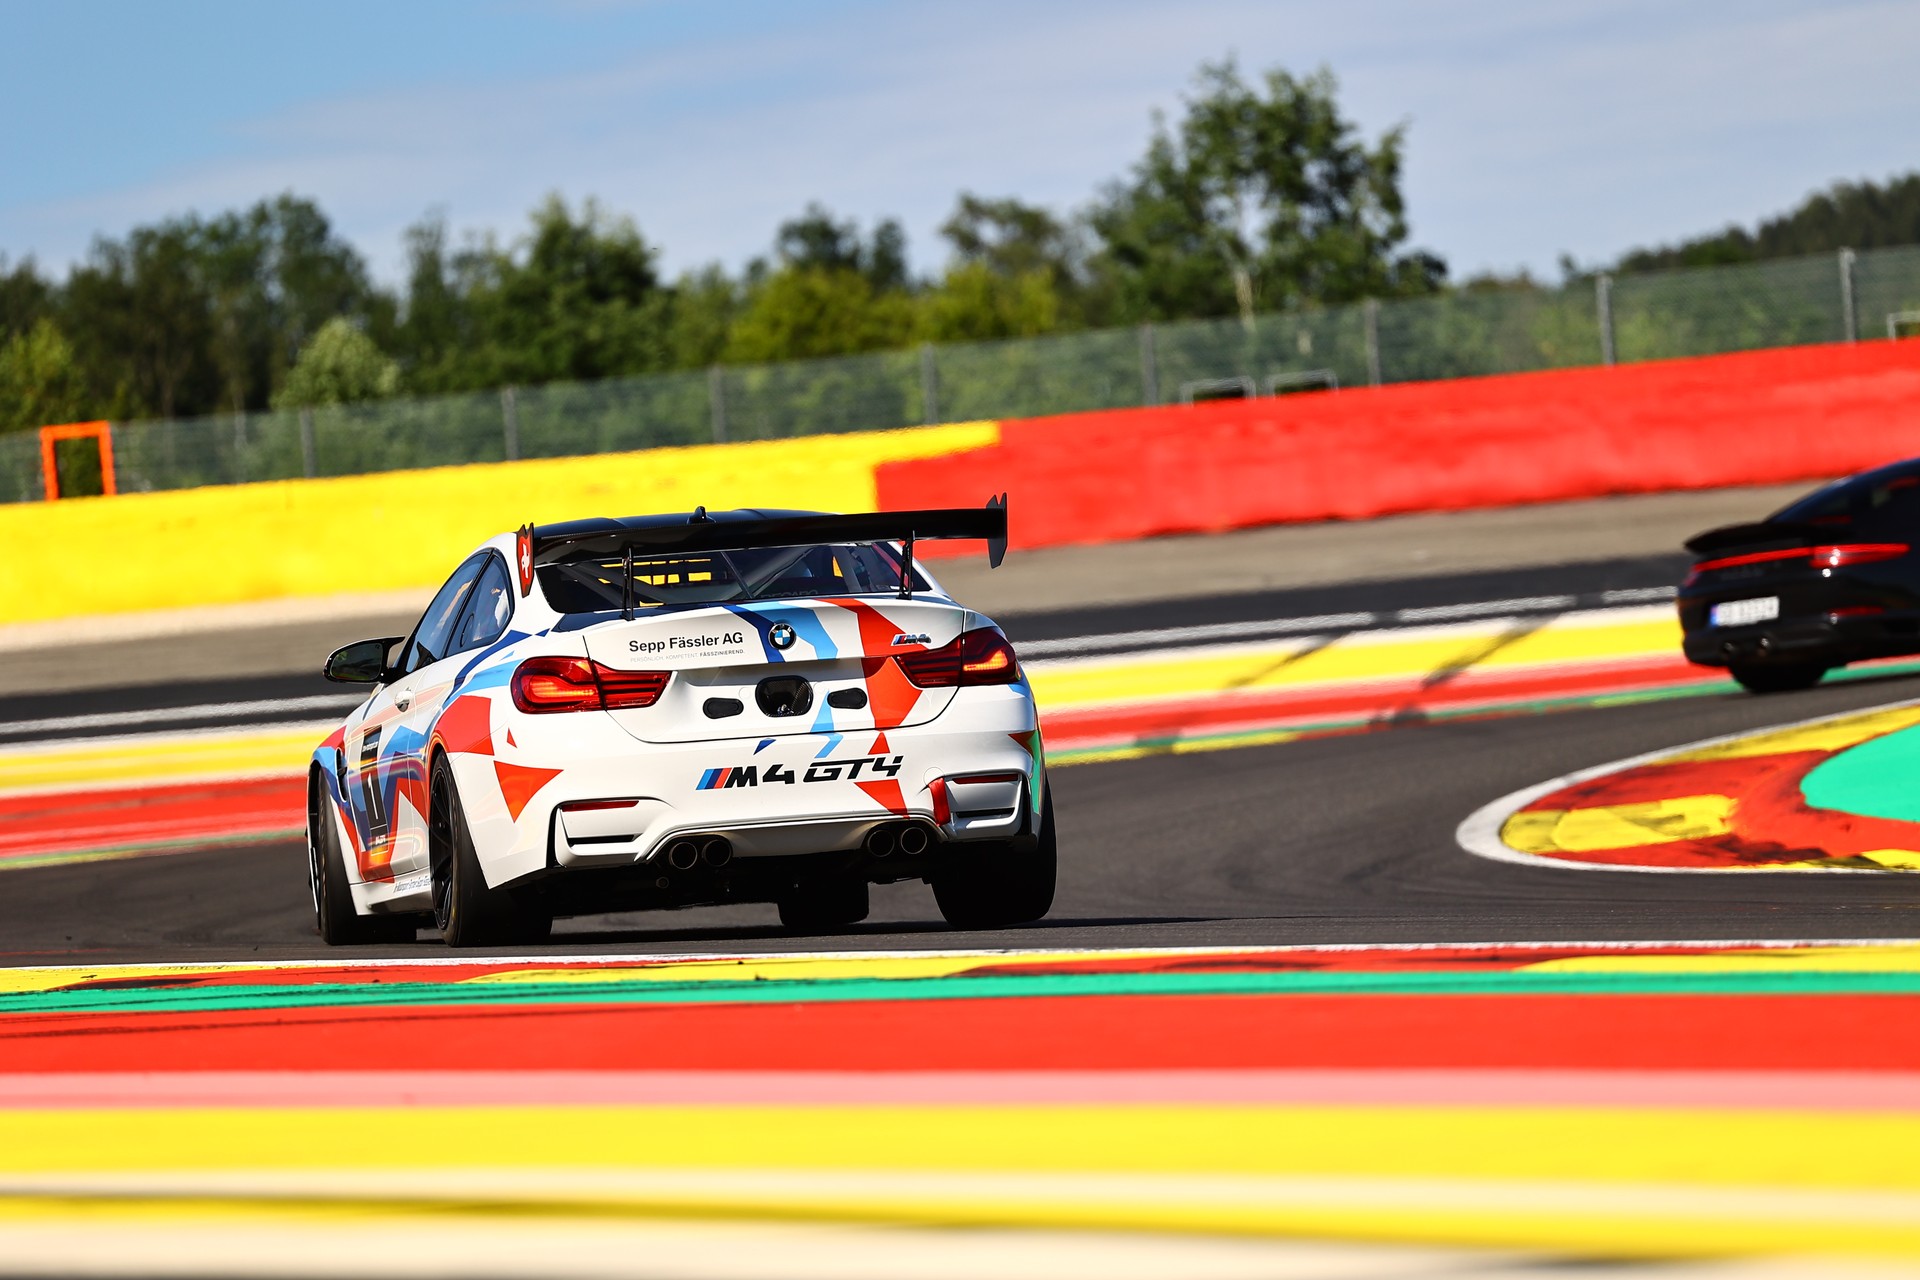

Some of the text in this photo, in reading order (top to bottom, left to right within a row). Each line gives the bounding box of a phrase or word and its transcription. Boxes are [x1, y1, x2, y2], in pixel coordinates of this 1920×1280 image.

[629, 632, 744, 653] Sepp Fässler AG
[803, 756, 904, 783] GT4
